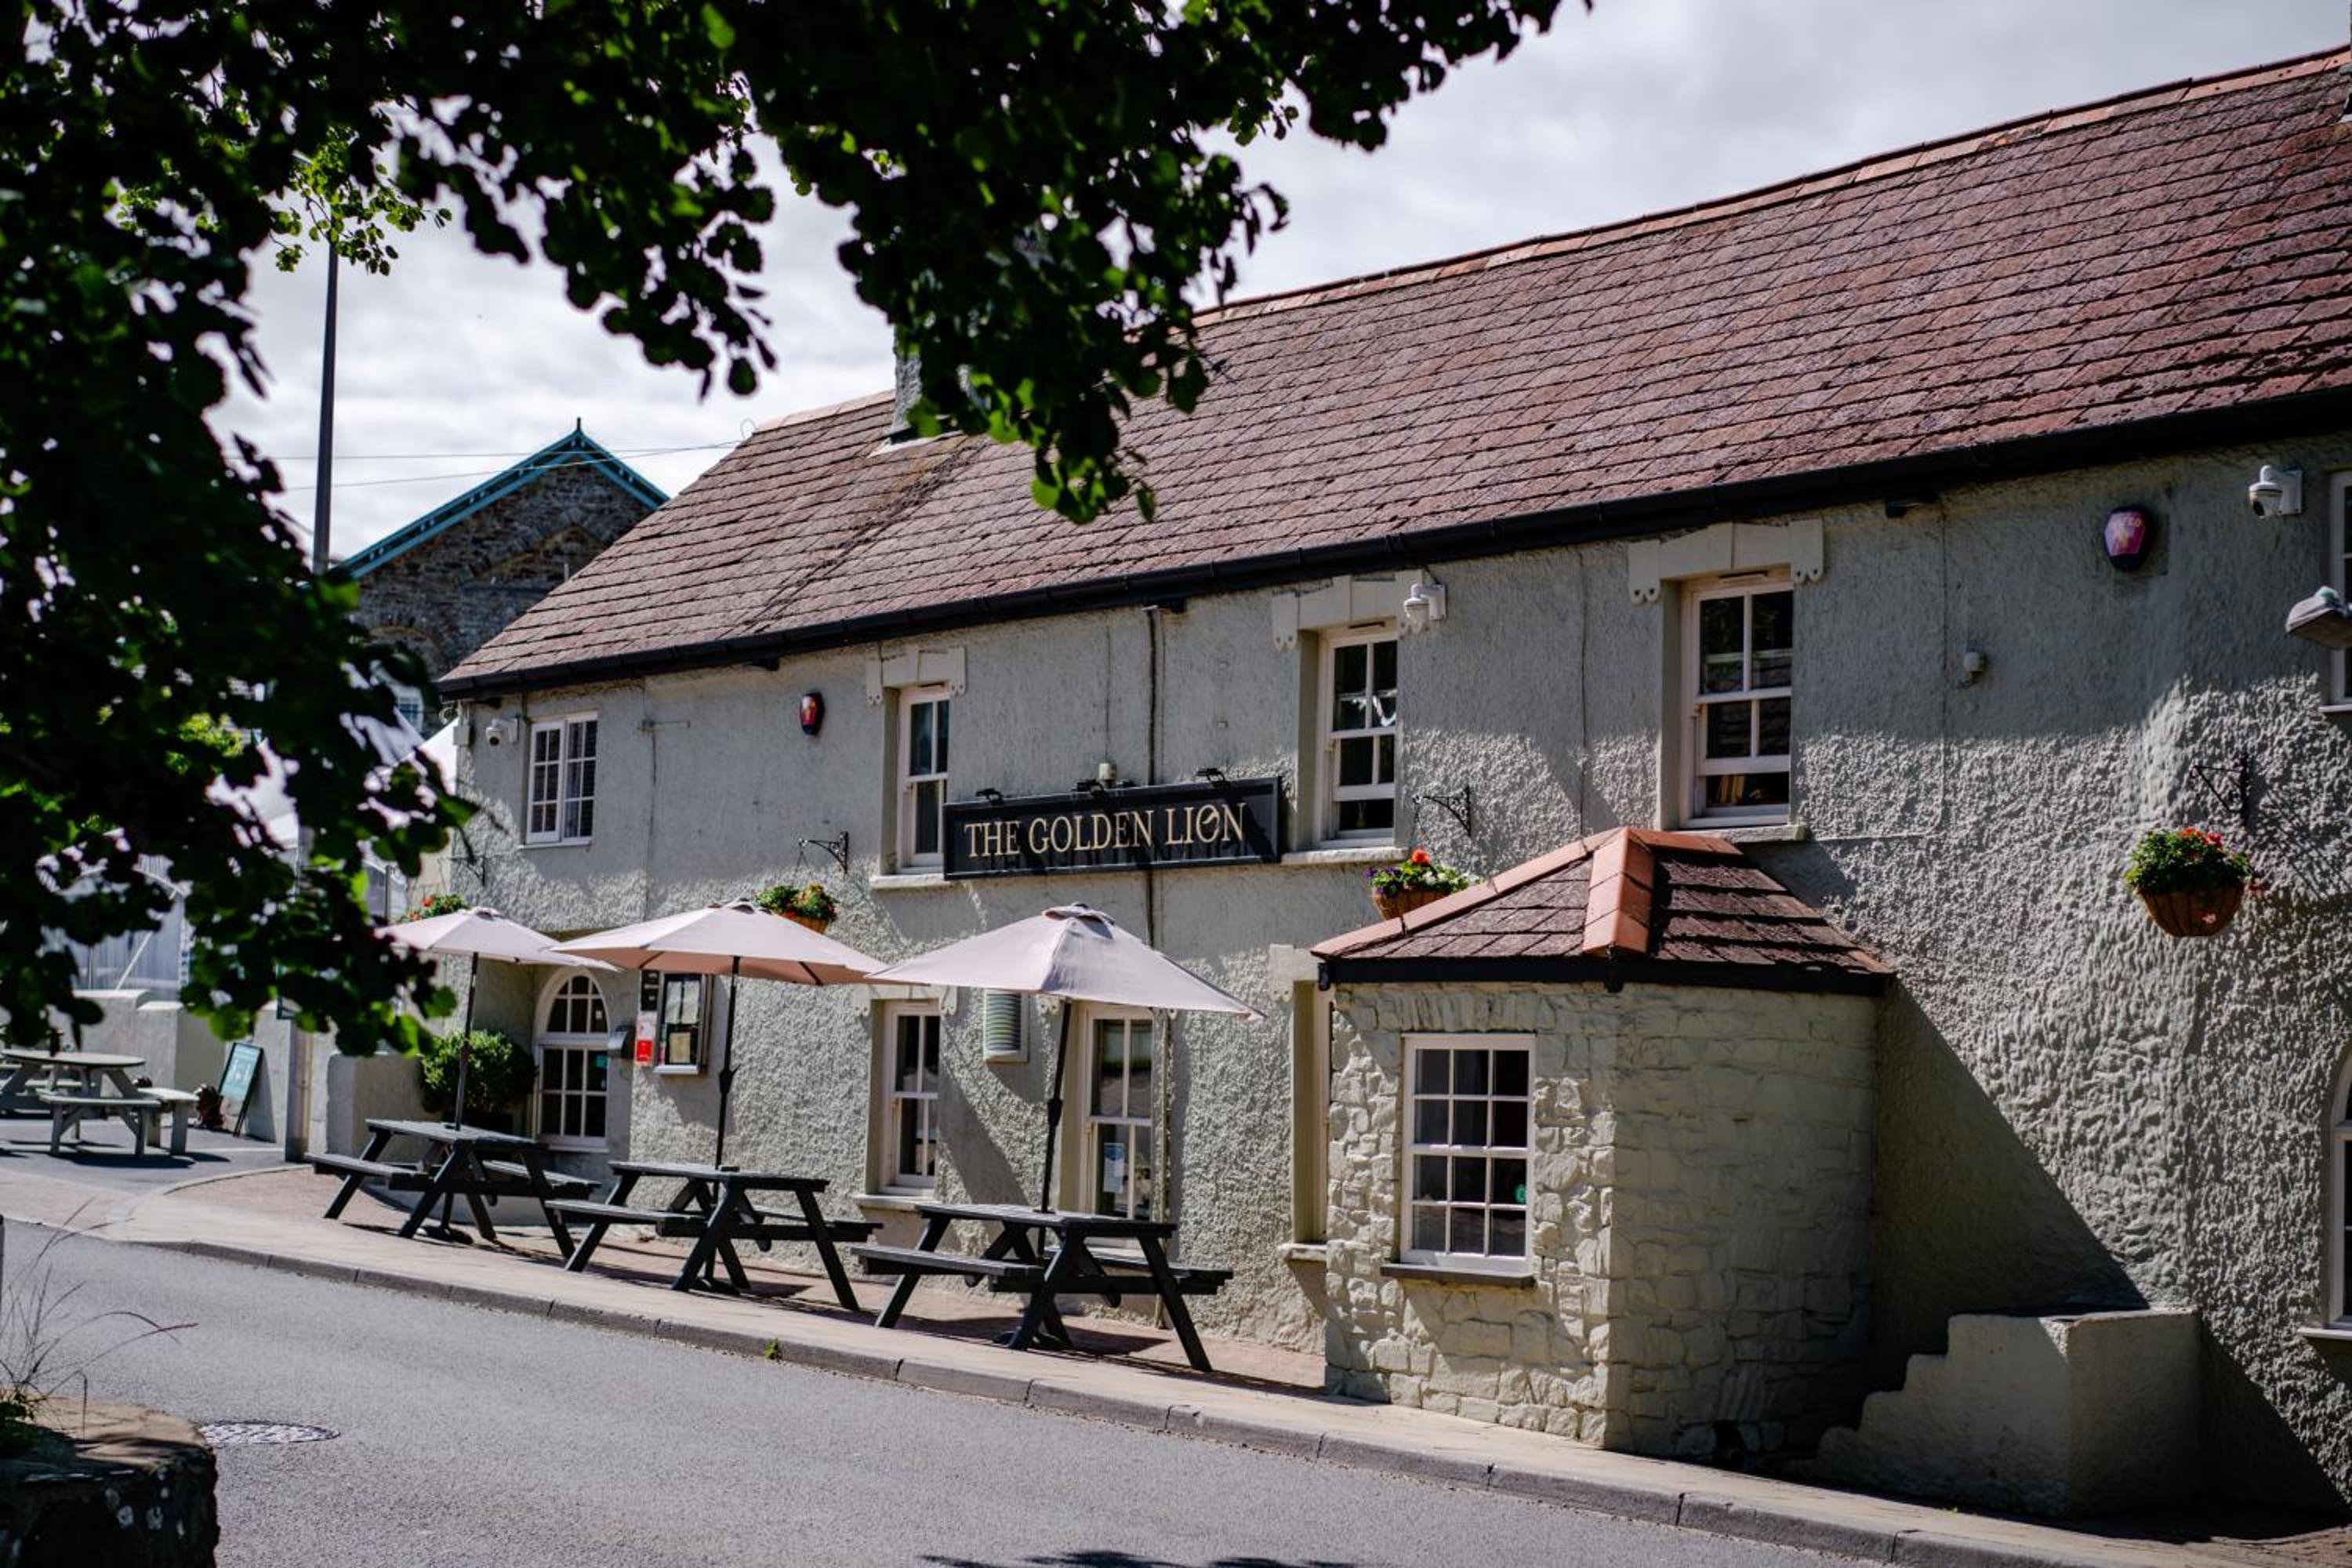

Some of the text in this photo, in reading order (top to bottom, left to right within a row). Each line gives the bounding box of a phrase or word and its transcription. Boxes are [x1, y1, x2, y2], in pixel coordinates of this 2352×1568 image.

[964, 803, 1247, 857] THE GOLDEN LION
